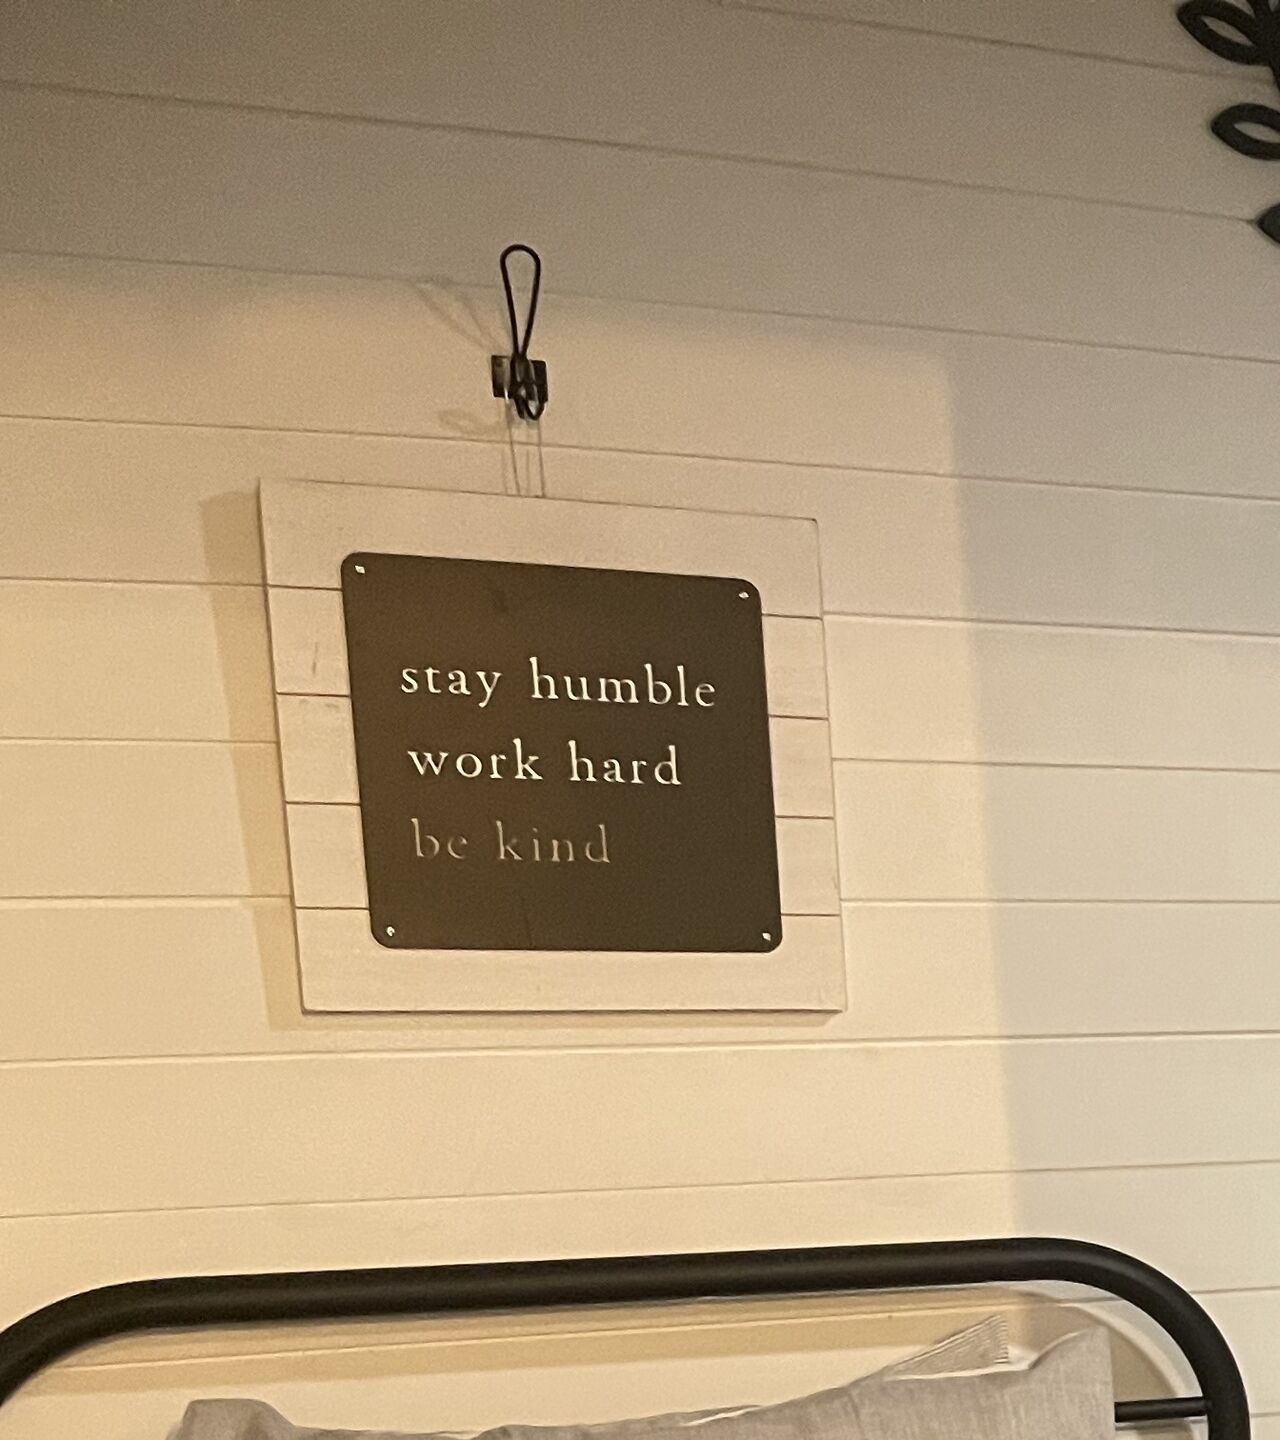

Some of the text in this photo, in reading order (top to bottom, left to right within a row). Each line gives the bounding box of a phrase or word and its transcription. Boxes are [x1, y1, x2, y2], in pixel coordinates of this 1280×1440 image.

[399, 656, 717, 708] stay humble
[407, 737, 682, 787] work hard
[411, 817, 611, 864] be kind
